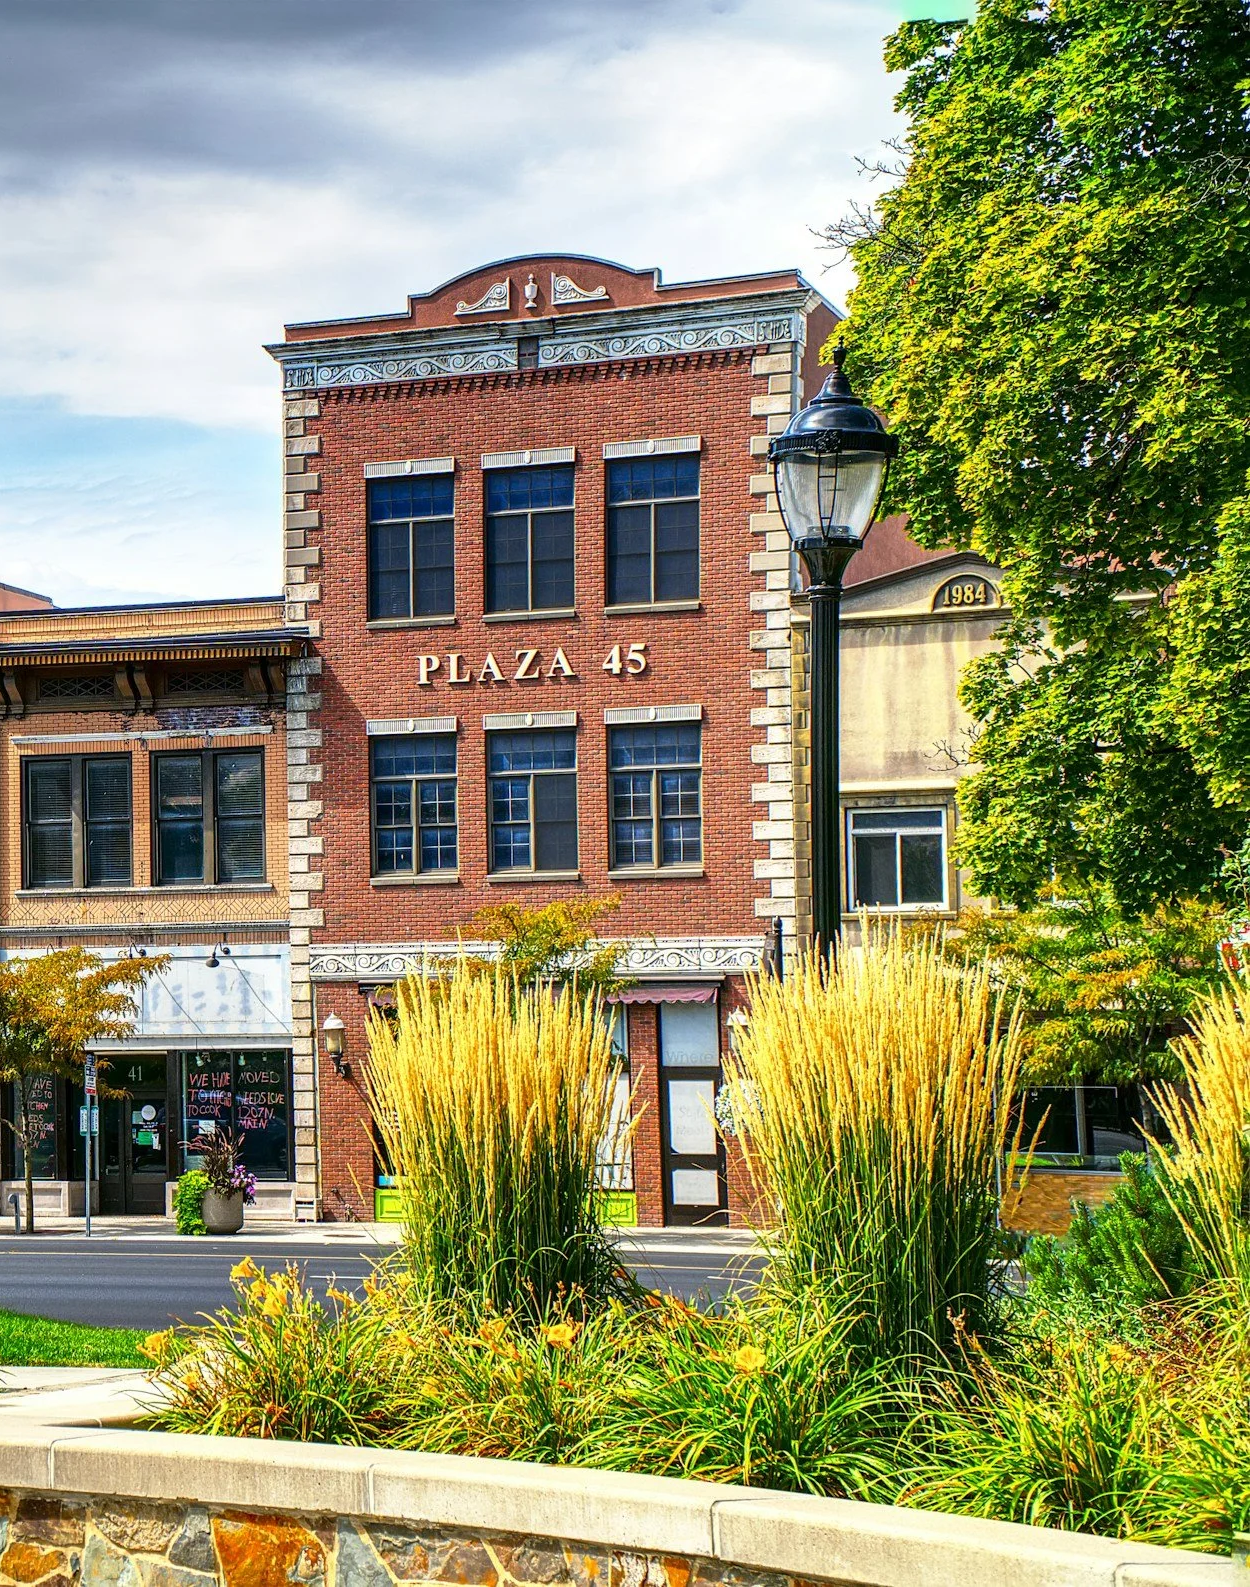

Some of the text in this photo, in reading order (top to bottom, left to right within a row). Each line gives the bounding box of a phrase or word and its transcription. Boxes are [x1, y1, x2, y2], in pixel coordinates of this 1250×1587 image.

[943, 582, 986, 605] 1984
[416, 643, 647, 685] PLAZA 45
[128, 1065, 143, 1081] 41
[189, 1072, 209, 1087] WE
[237, 1071, 281, 1085] MOVED
[187, 1089, 207, 1103] TO
[187, 1104, 199, 1118] TO
[199, 1104, 221, 1118] COOK
[237, 1119, 268, 1130] MAIN
